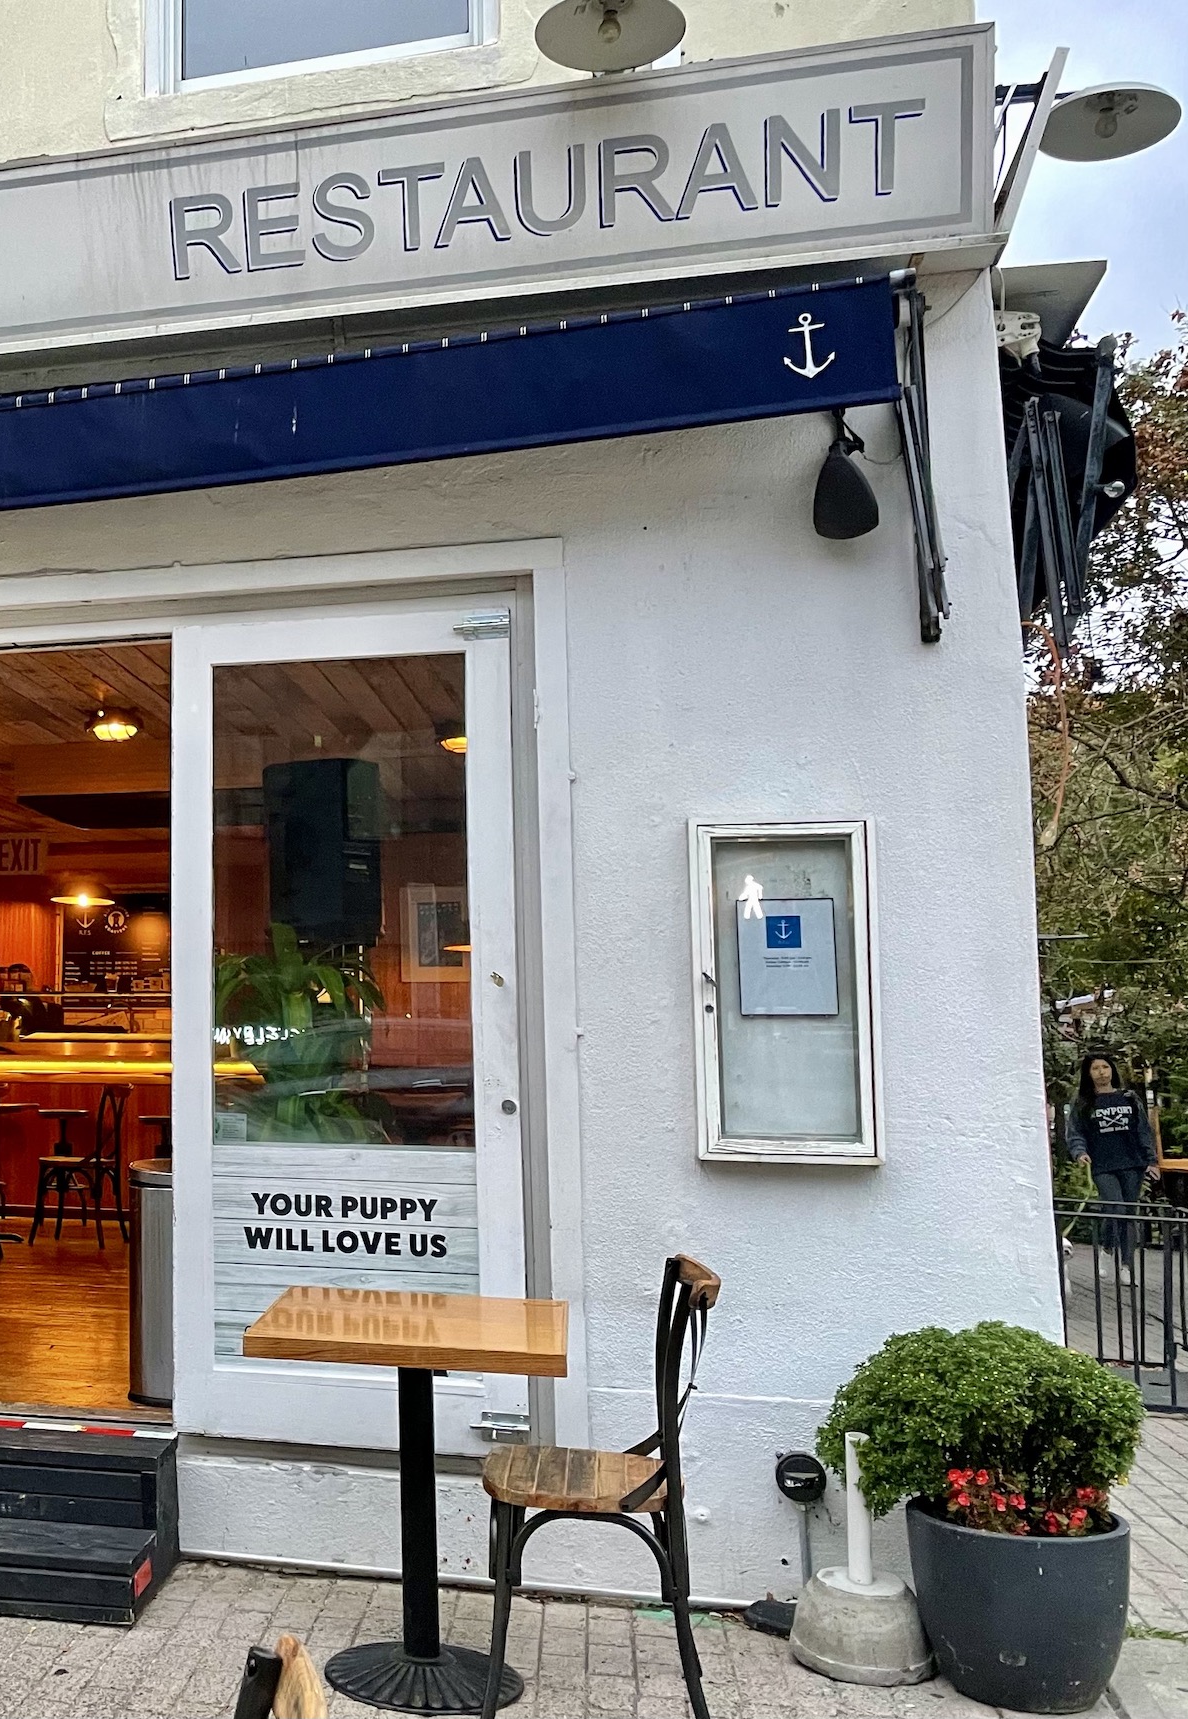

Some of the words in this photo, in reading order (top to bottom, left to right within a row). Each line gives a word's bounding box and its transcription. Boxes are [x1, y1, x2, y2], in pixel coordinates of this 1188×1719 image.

[169, 97, 927, 282] RESTAURANT
[250, 1191, 334, 1219] YOUR
[341, 1195, 439, 1223] PUPPY
[243, 1226, 315, 1253] WILL
[322, 1229, 402, 1256] LOVE
[409, 1233, 448, 1258] US
